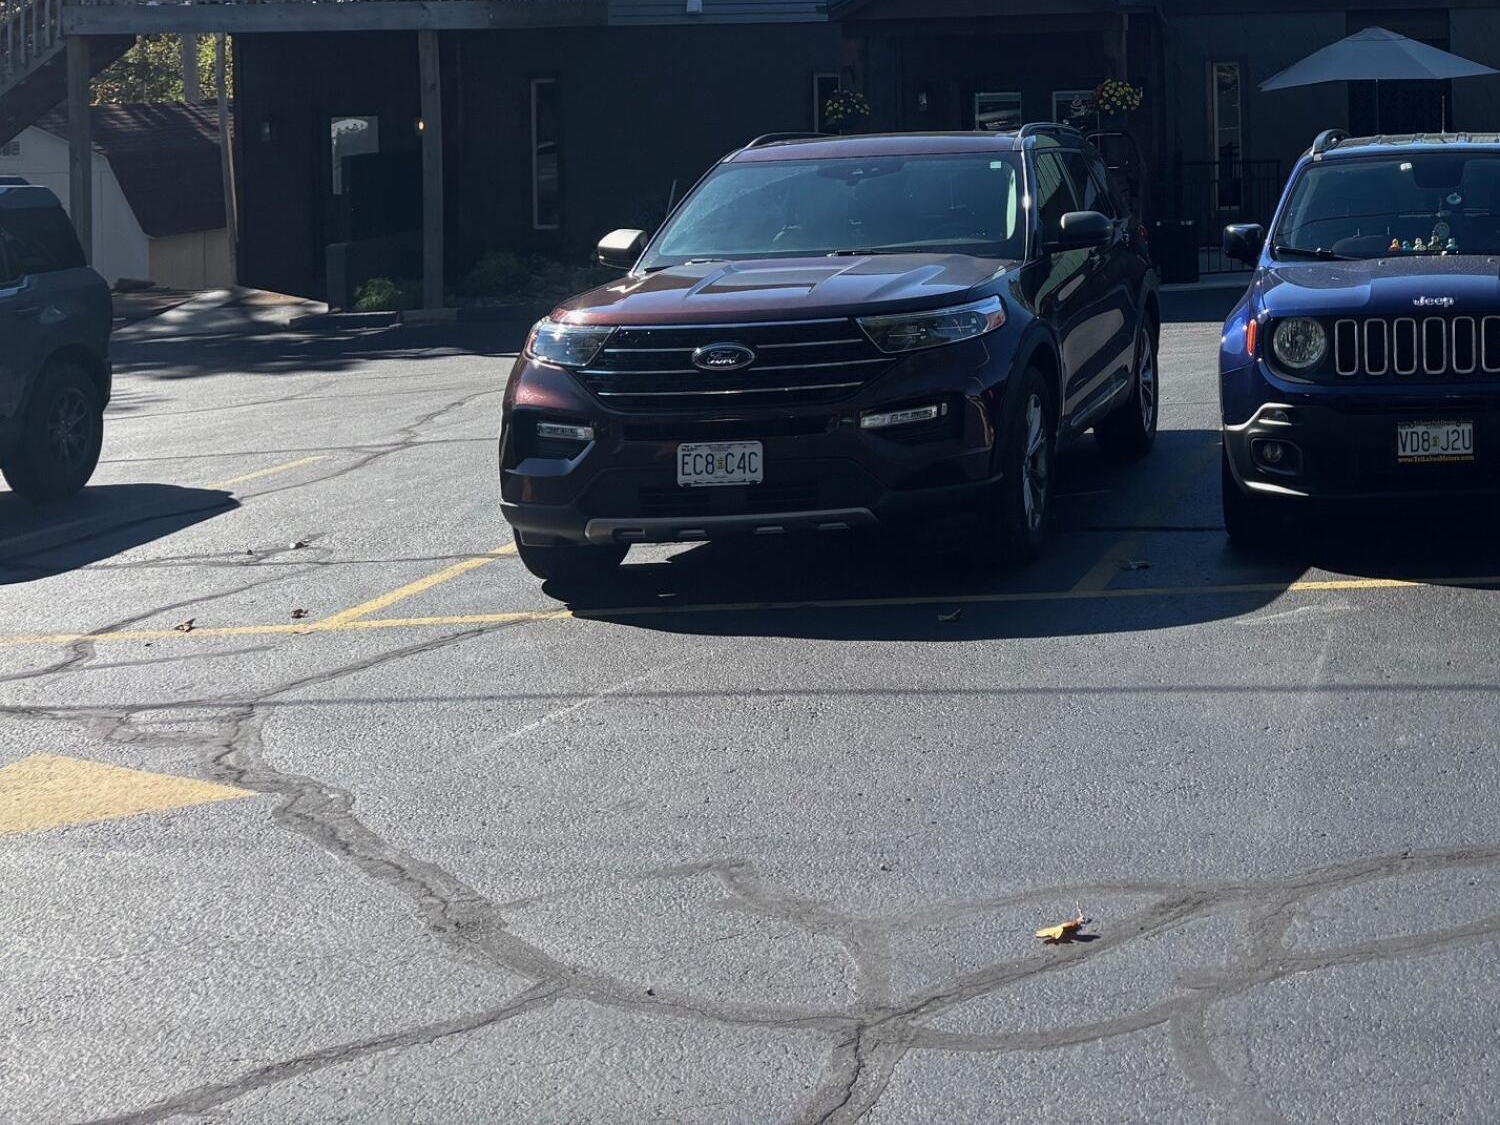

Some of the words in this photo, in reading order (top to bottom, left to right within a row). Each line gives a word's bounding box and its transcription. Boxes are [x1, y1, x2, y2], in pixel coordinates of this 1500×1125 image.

[1412, 296, 1455, 308] Jeep
[707, 350, 740, 364] Ford
[681, 453, 715, 475] EC8
[725, 452, 758, 474] C4C
